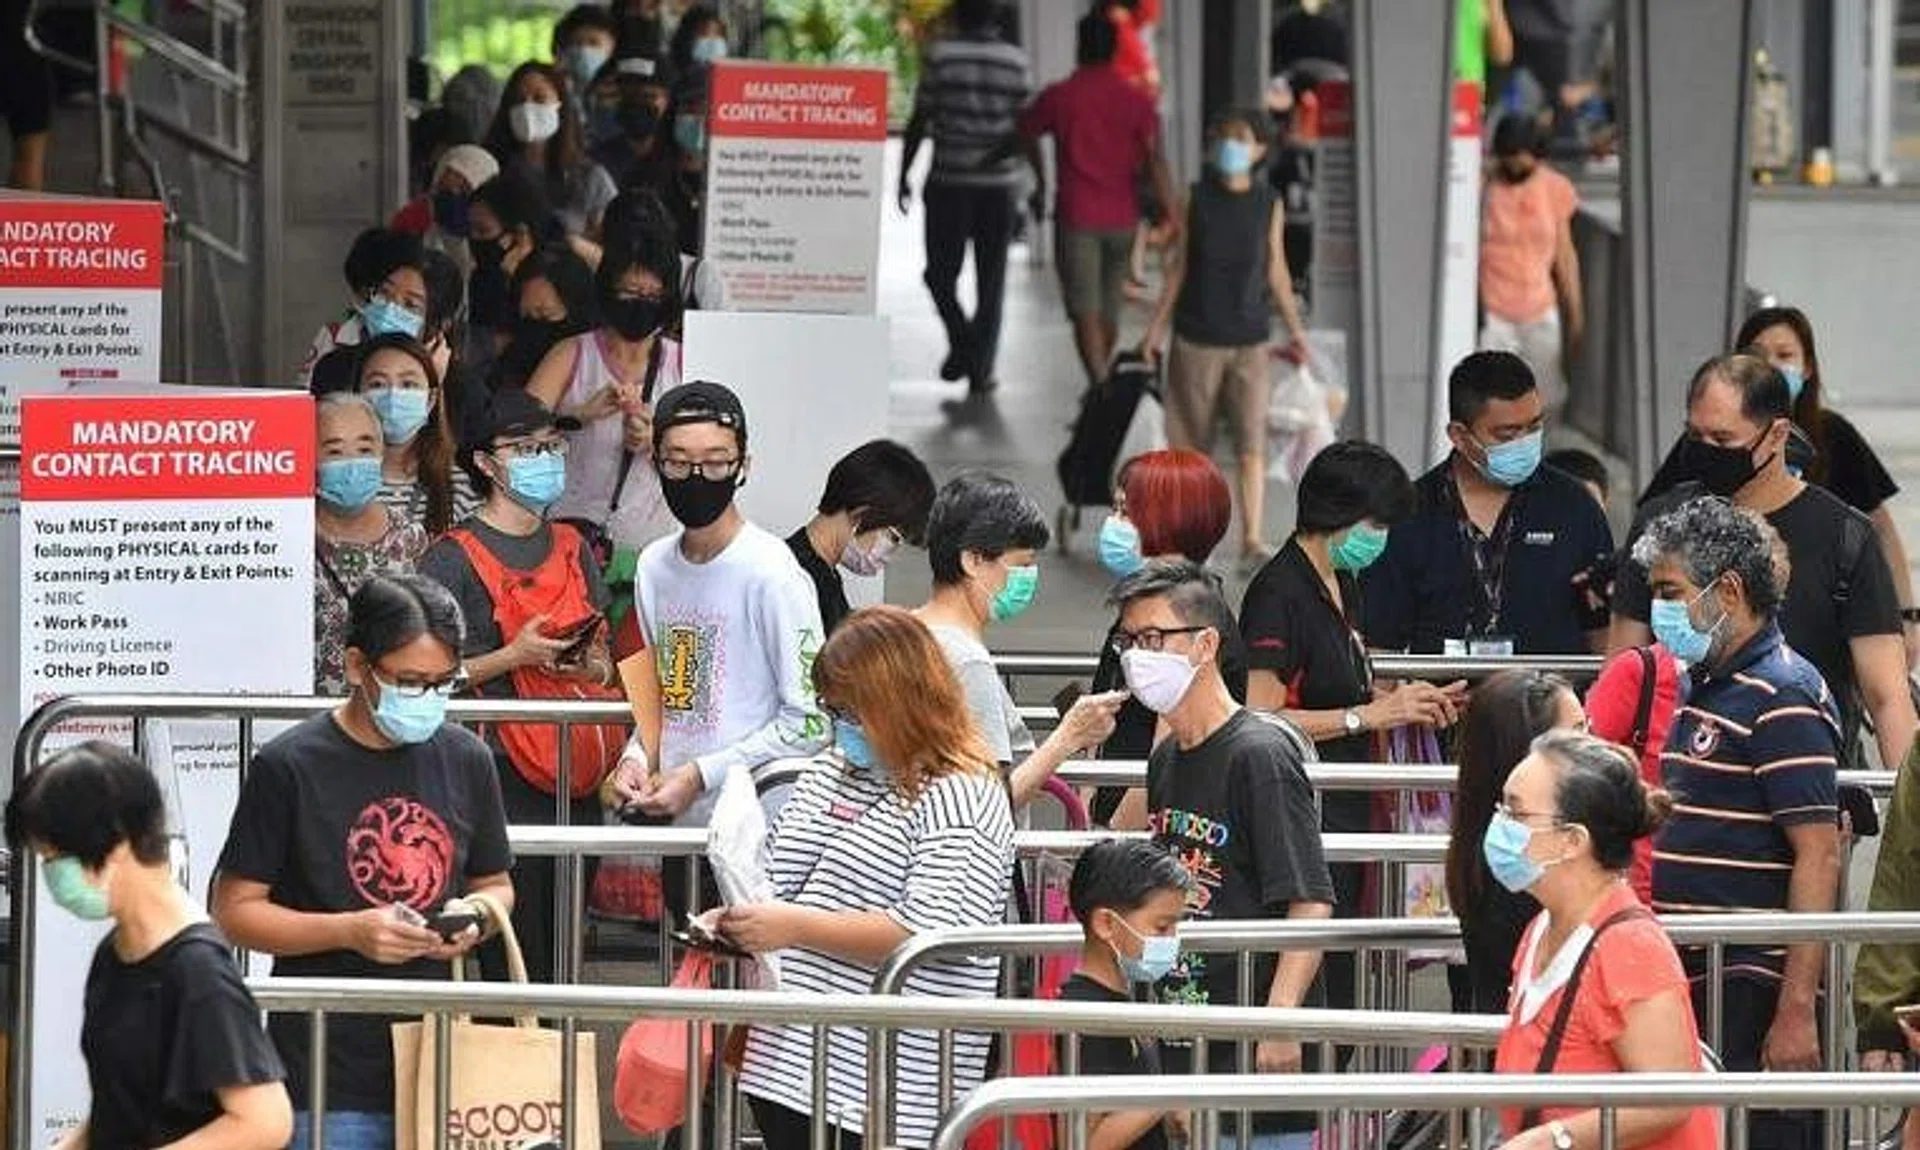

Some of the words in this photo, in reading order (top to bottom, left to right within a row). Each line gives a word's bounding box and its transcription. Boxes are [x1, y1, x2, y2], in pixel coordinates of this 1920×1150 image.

[744, 82, 855, 102] MANDATORY
[718, 103, 798, 123] CONTACT
[802, 105, 877, 125] TRACING
[4, 221, 115, 242] NDATORY
[44, 247, 148, 269] TRACING
[5, 304, 57, 317] present
[59, 306, 84, 317] any
[88, 303, 102, 315] of
[105, 303, 128, 315] the
[0, 322, 67, 336] PHYSICAL
[71, 324, 107, 336] cards
[111, 322, 130, 336] for
[13, 342, 49, 358] Entry
[53, 343, 63, 355] &
[67, 343, 92, 355] Exit
[96, 343, 141, 355] Points:
[73, 420, 255, 445] MANDATORY
[32, 453, 164, 477] CONTACT
[170, 450, 296, 475] TRACING
[34, 519, 64, 534] You
[69, 518, 117, 533] MUST
[123, 518, 185, 536] present
[191, 520, 220, 536] any
[225, 516, 242, 531] of
[246, 516, 273, 531] the
[34, 543, 113, 561] following
[118, 541, 201, 557] PHYSICAL
[205, 540, 250, 556] cards
[254, 540, 278, 555] for
[33, 566, 110, 584] scanning
[113, 567, 130, 581] at
[135, 566, 179, 584] Entry
[183, 566, 196, 580] &
[200, 565, 232, 580] Exit
[236, 564, 294, 580] Points:
[44, 591, 85, 605] NRIC
[43, 614, 87, 630] Work
[91, 614, 128, 629] Pass
[44, 639, 106, 656] Driving
[111, 637, 172, 653] Licence
[43, 662, 92, 678] Other
[96, 661, 147, 678] Photo
[151, 661, 170, 676] ID
[172, 740, 215, 753] personal
